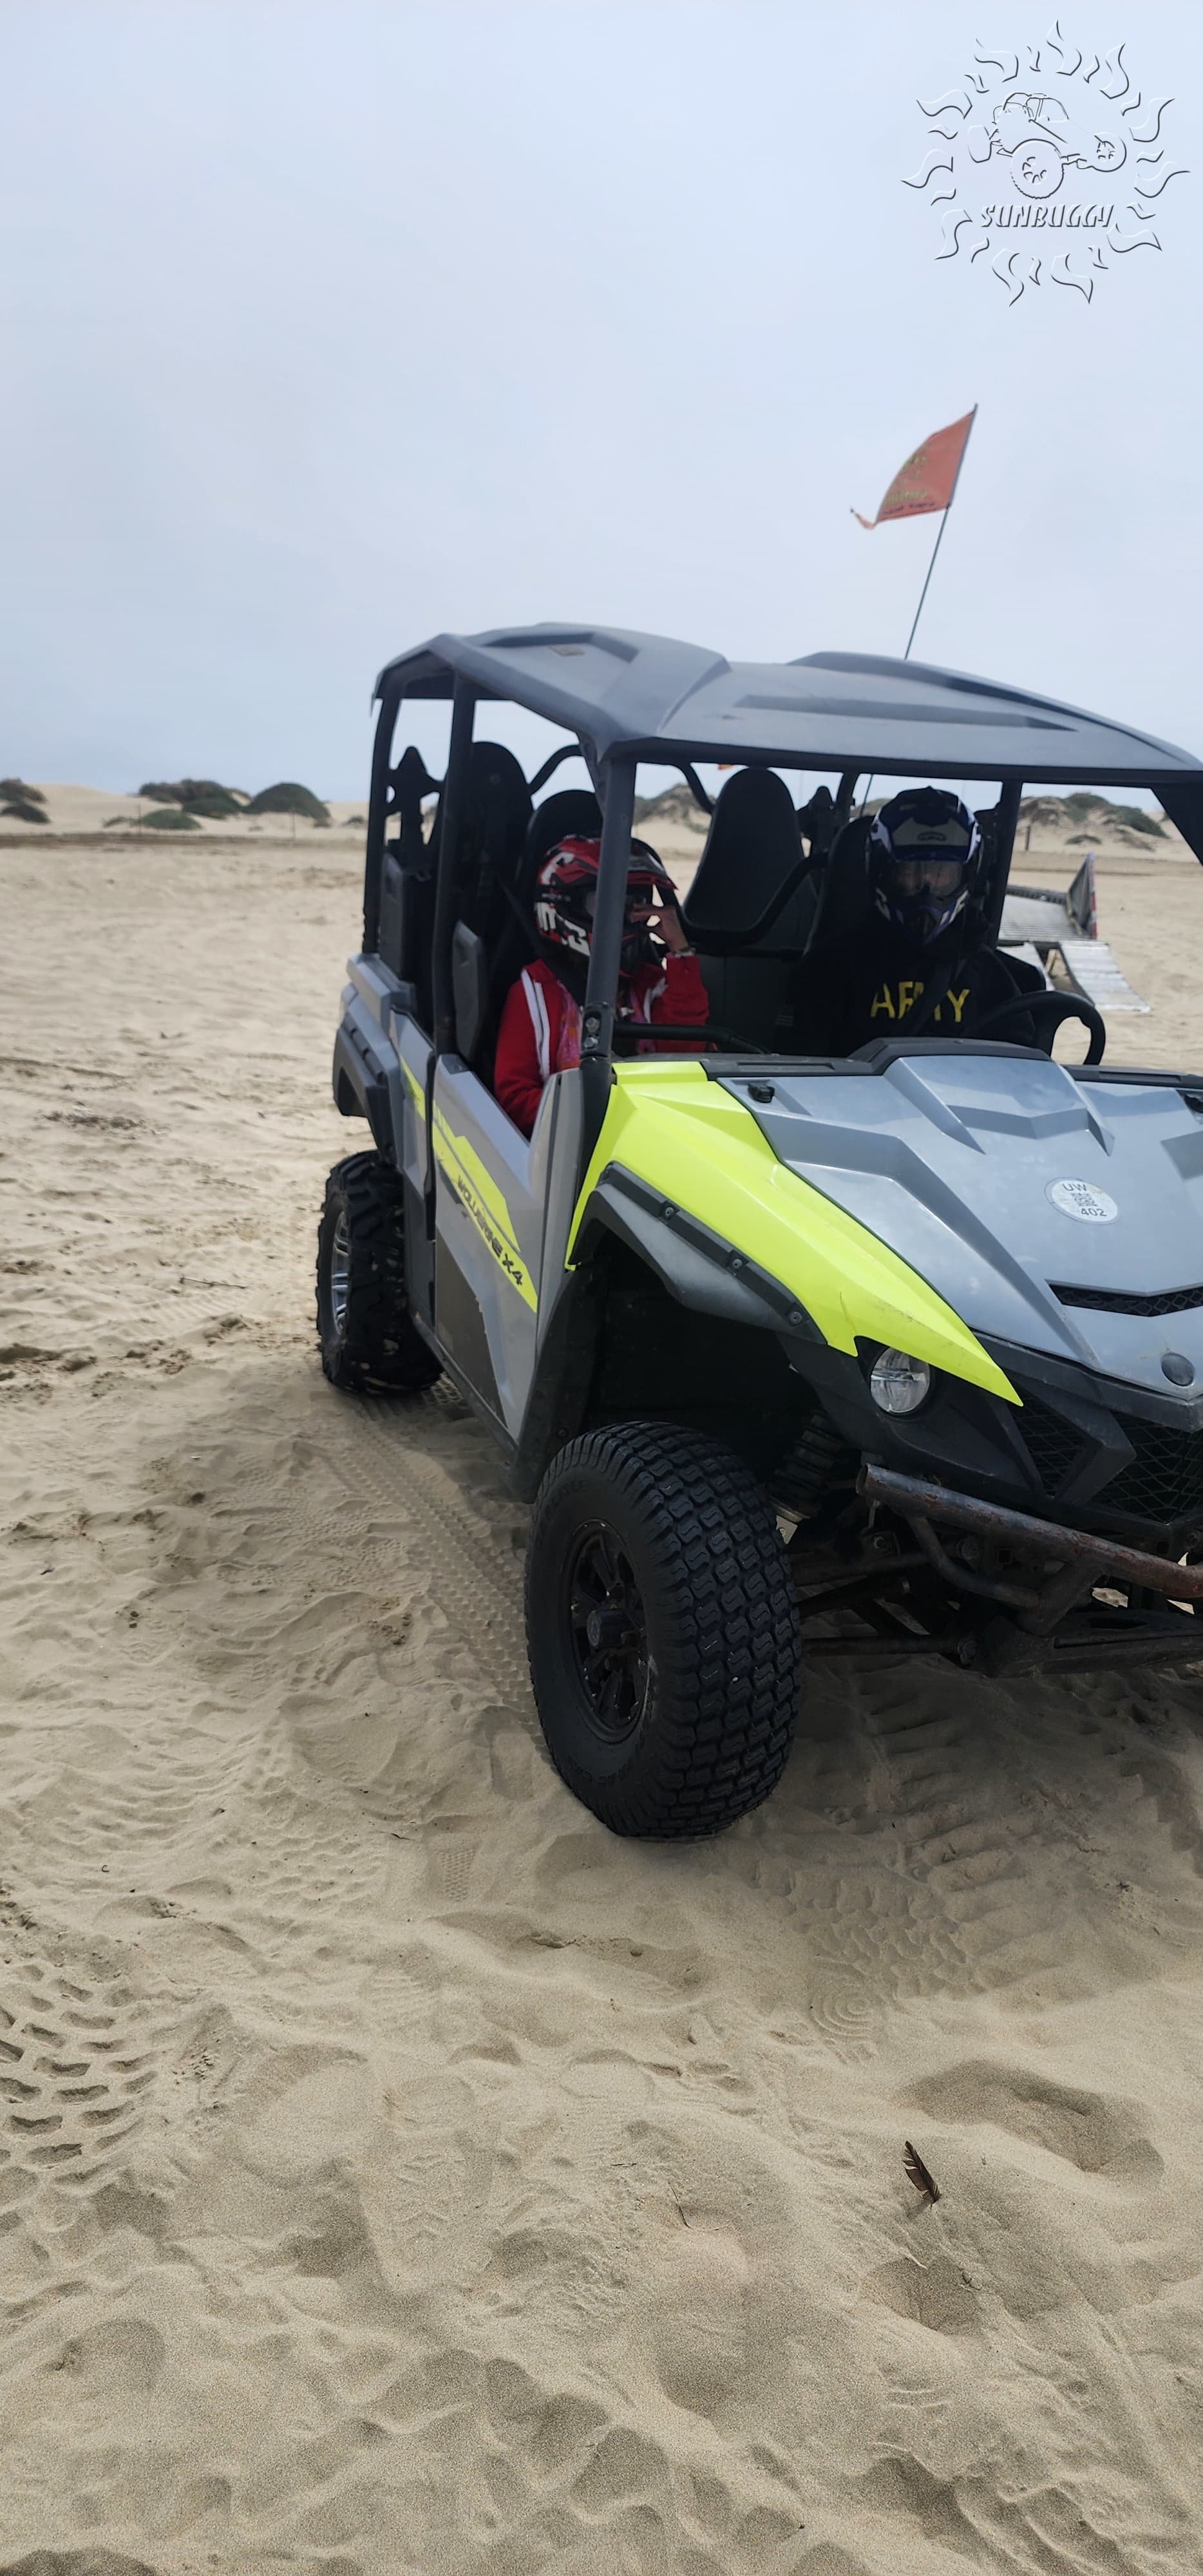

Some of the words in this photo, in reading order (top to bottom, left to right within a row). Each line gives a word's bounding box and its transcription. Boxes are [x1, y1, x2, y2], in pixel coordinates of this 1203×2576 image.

[1061, 1183, 1087, 1191] UW
[1081, 1208, 1107, 1217] 402
[502, 1252, 522, 1285] X4
